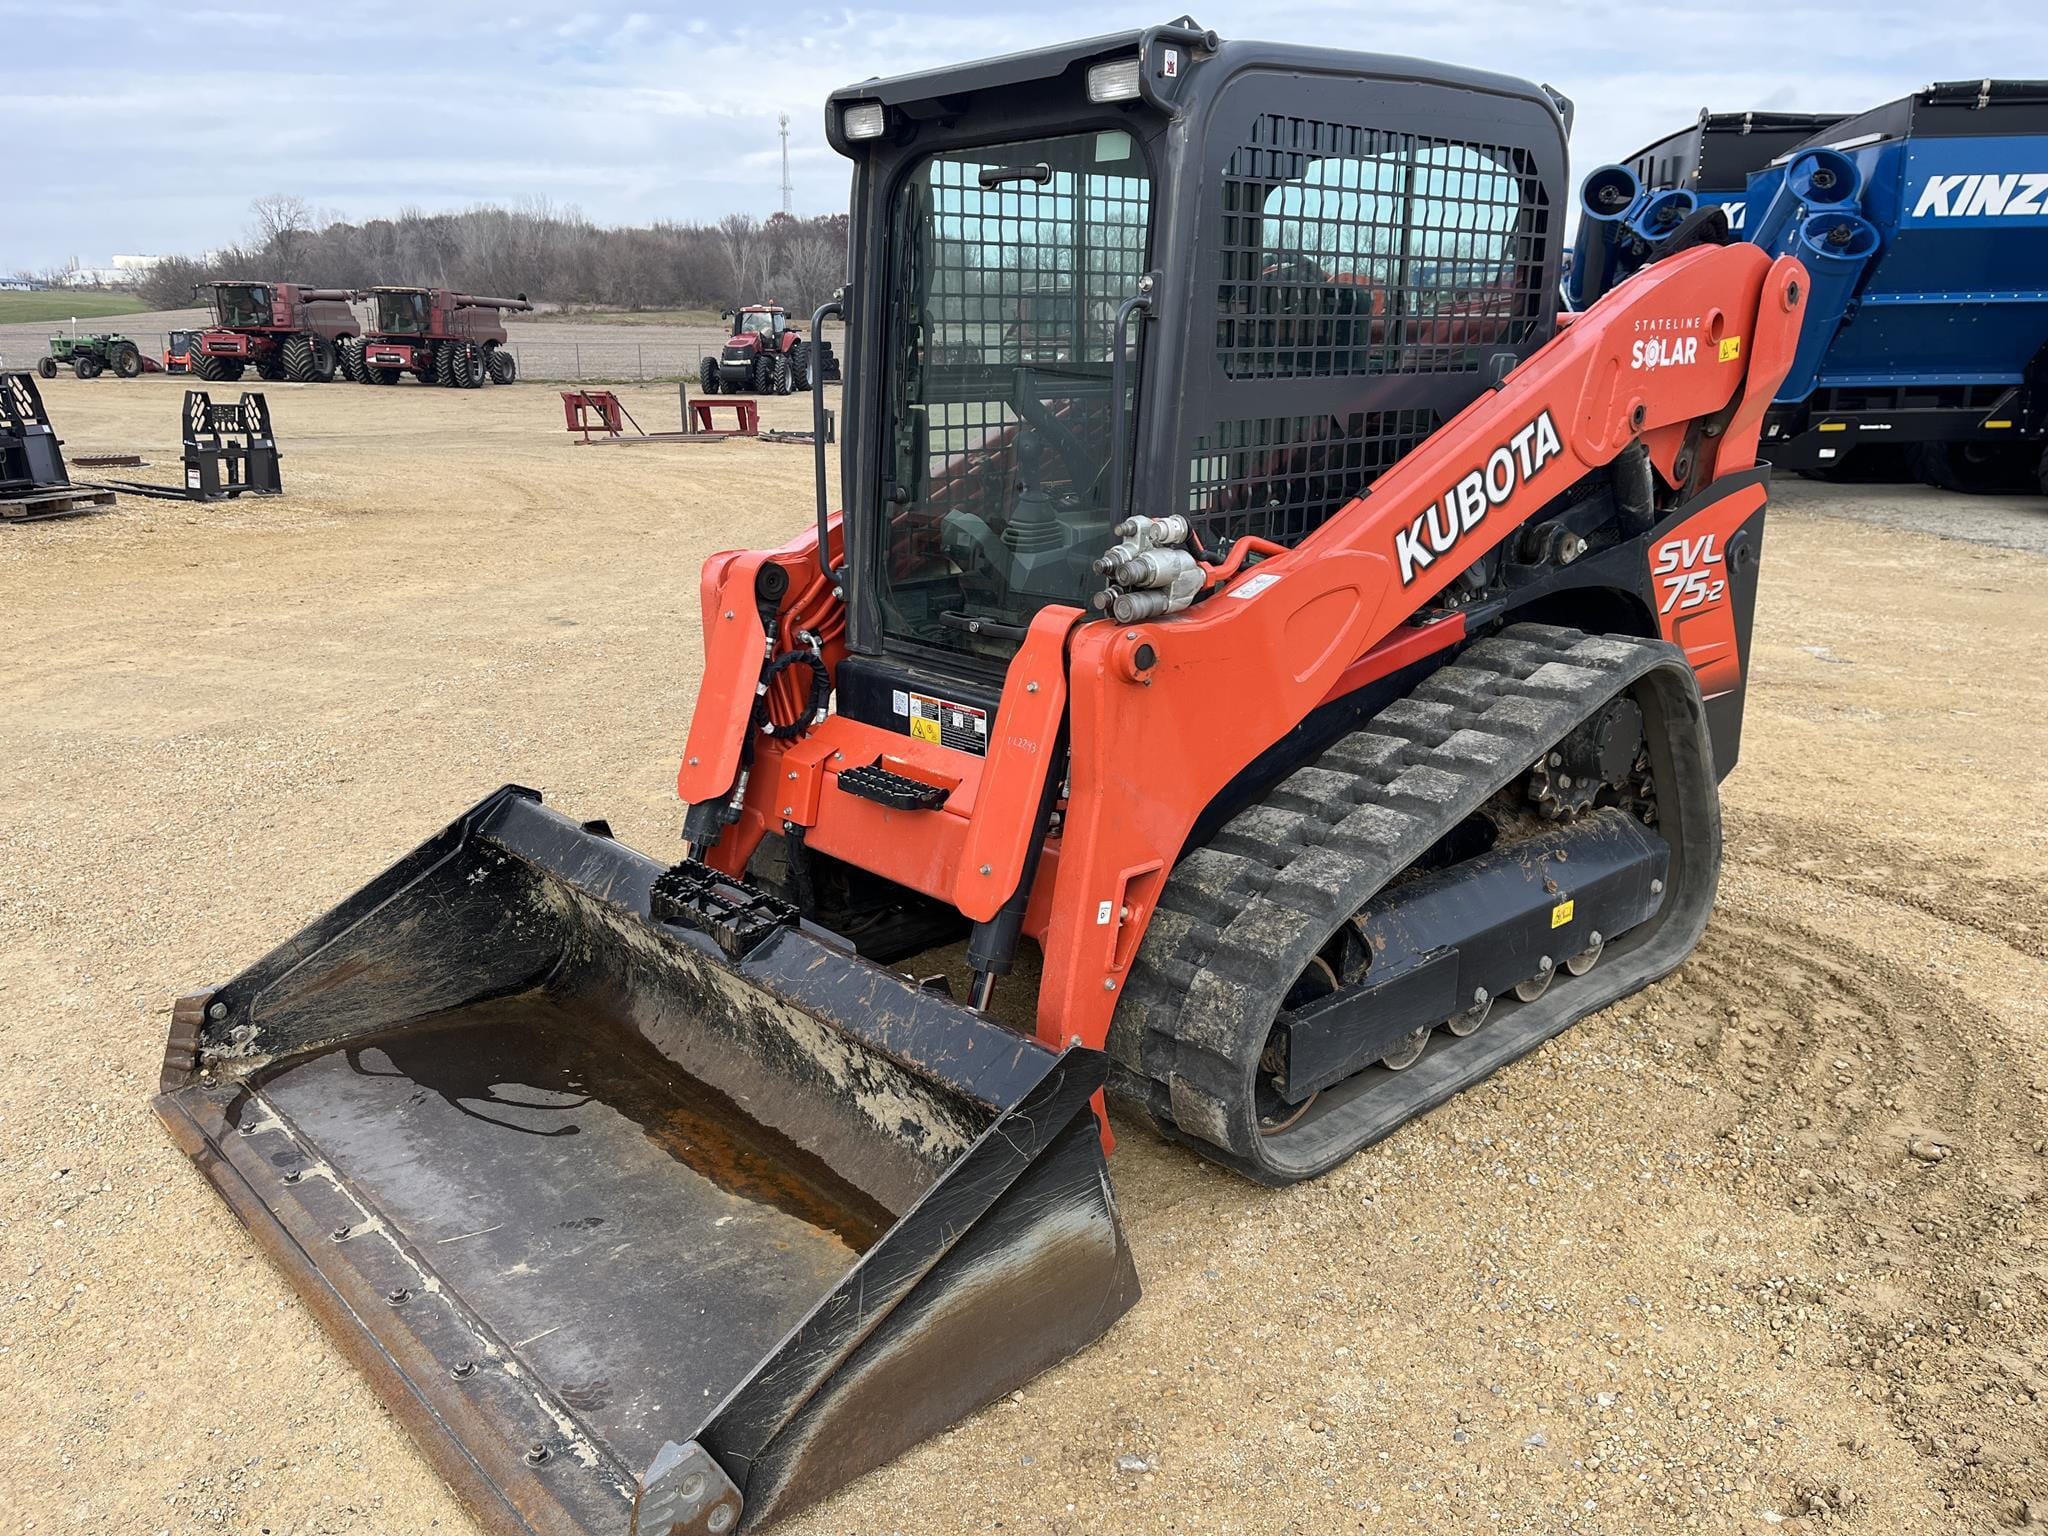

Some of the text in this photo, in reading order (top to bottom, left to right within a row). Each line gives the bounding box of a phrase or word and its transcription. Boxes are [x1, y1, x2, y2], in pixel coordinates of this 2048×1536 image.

[1912, 173, 2048, 217] KINZ
[1634, 317, 1701, 332] STATELINE
[1631, 336, 1698, 370] SOLAR
[1395, 411, 1561, 584] KUBOTA
[1653, 534, 1723, 576] SVL
[1660, 569, 1725, 615] 75-2
